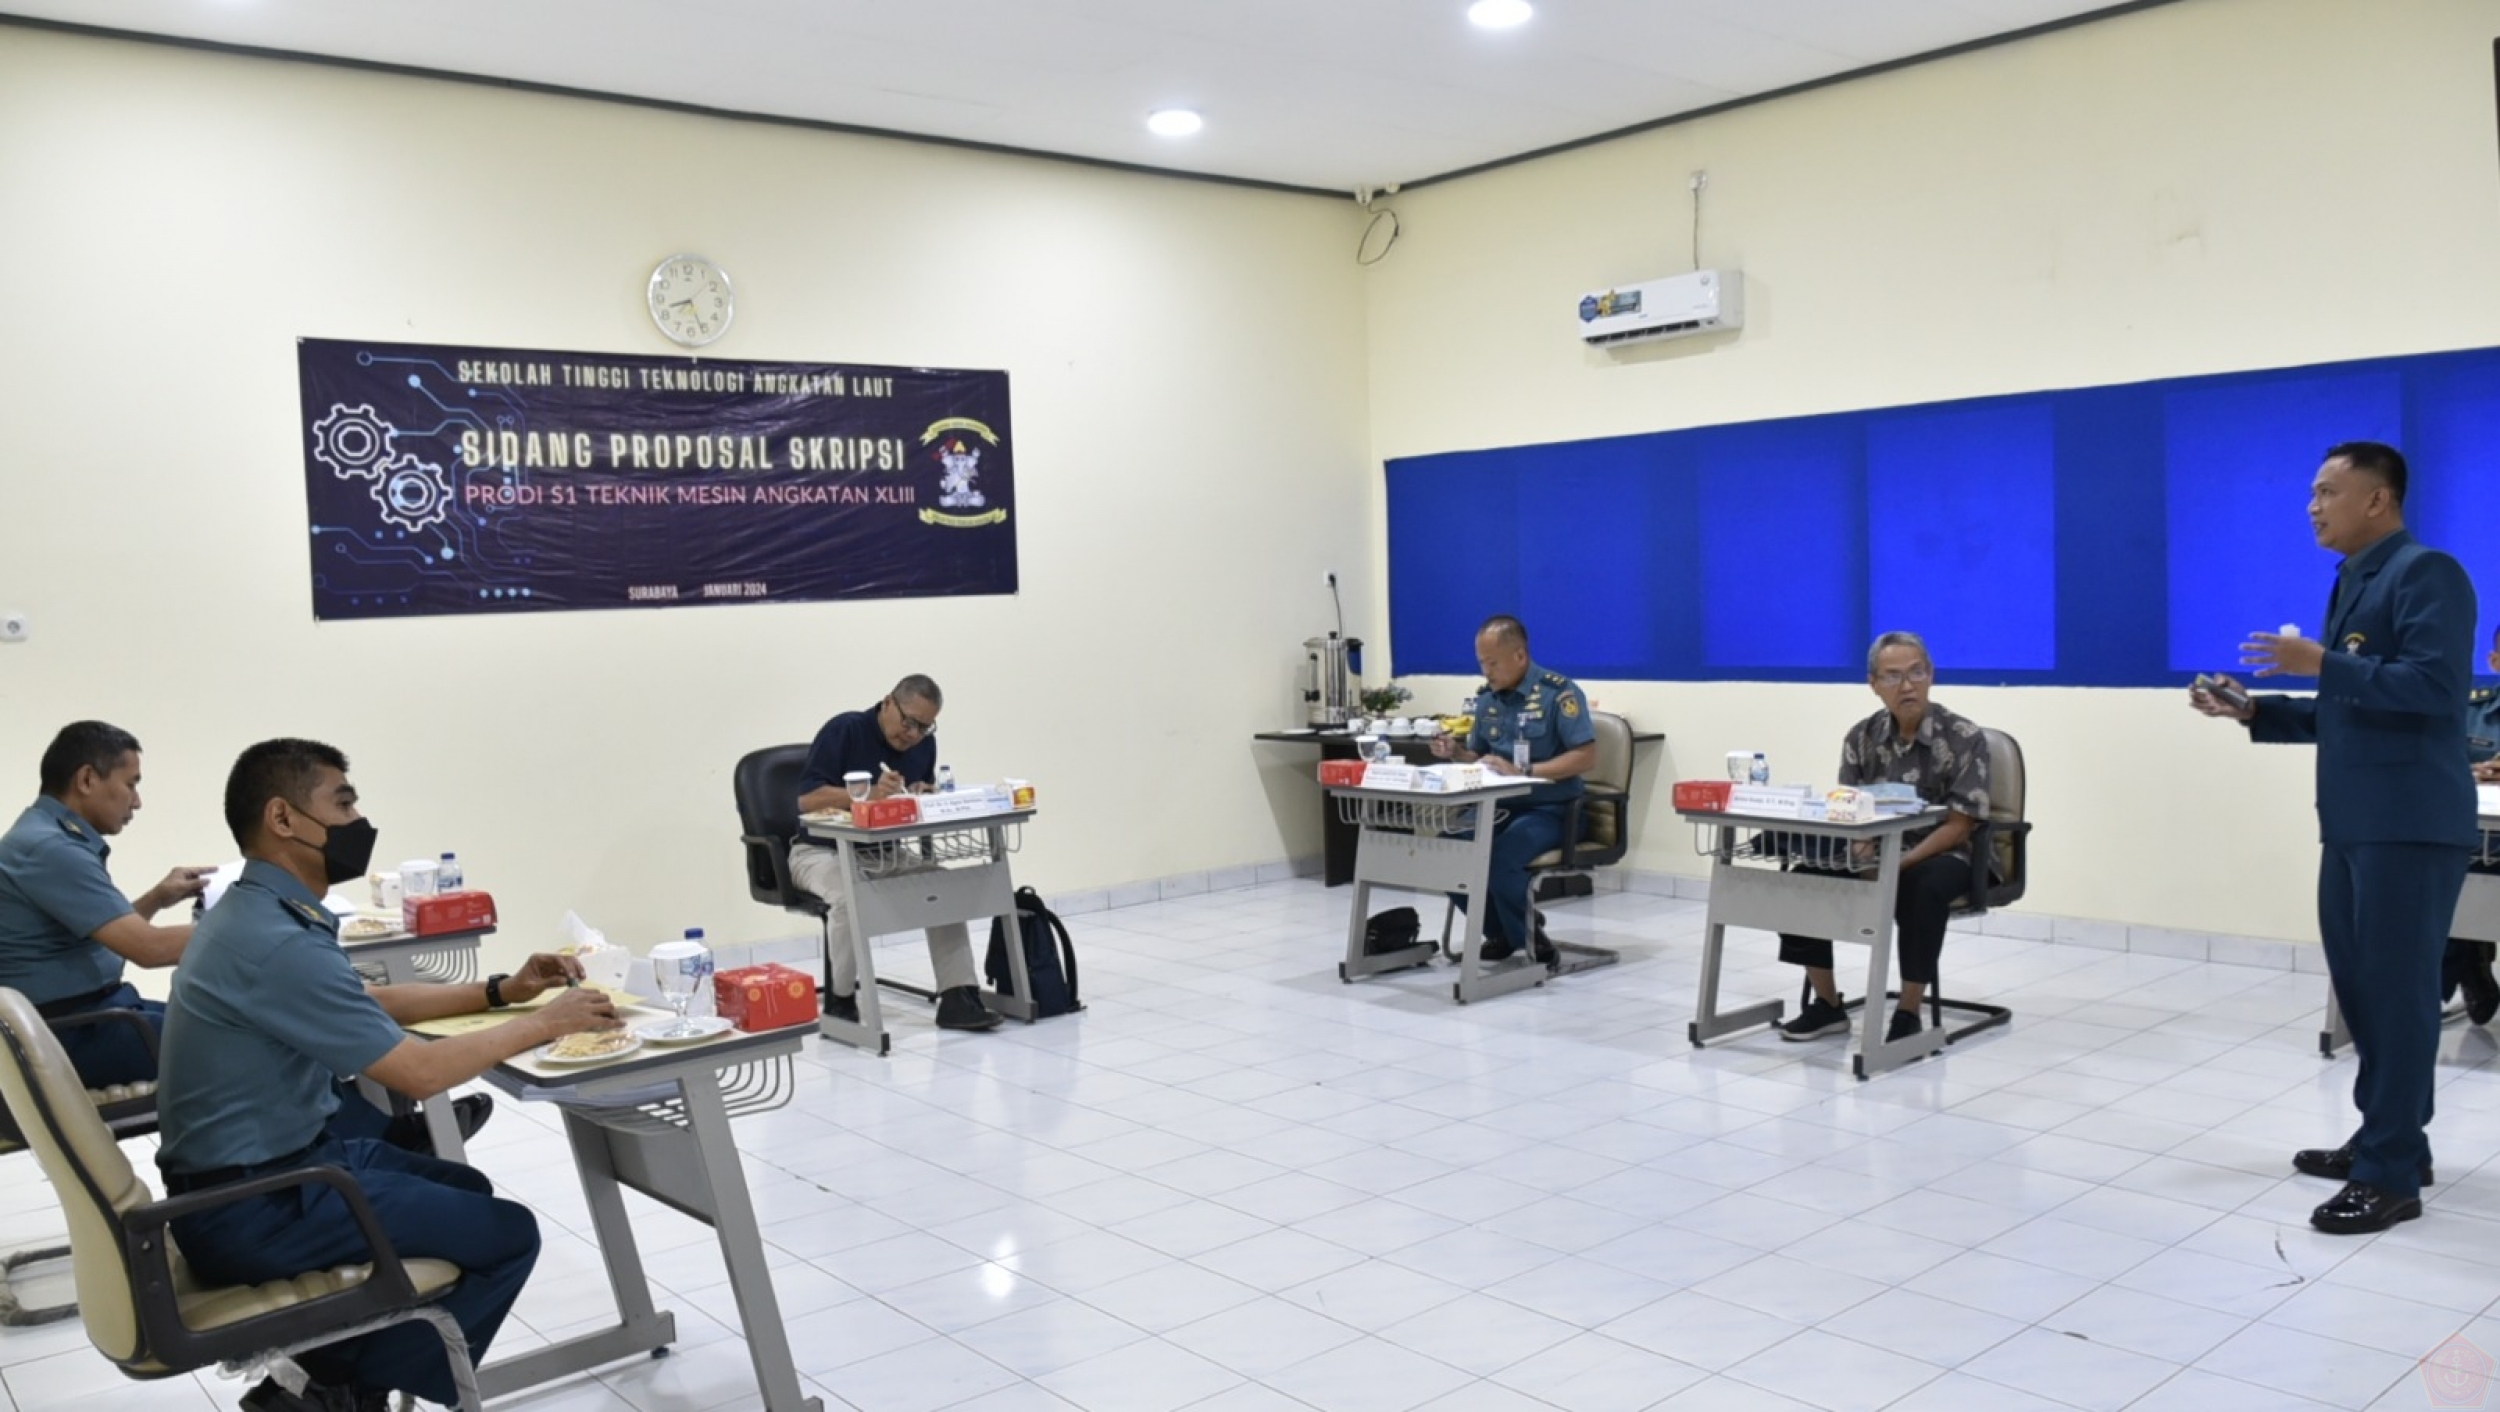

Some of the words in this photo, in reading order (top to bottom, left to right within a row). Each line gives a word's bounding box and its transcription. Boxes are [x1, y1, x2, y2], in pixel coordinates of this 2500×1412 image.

[458, 360, 551, 386] SEKOLAH
[561, 364, 630, 389] TINGGI
[640, 368, 744, 393] TEKNOLOGI
[753, 372, 845, 396] ANGKATAN
[853, 377, 894, 397] LAUT
[462, 430, 593, 467] SIDANG
[610, 433, 773, 469] PROPOSAL
[789, 437, 904, 470] SKRIPSI
[465, 485, 543, 504] PRODI
[551, 485, 577, 504] S1
[585, 486, 670, 504] TEKNIK
[677, 486, 746, 504] MESIN
[753, 486, 869, 504] ANGKATAN
[874, 486, 915, 504] XLIII
[628, 585, 678, 600] SURABAYA
[703, 582, 742, 597] JANUARI
[744, 582, 767, 596] 2024
